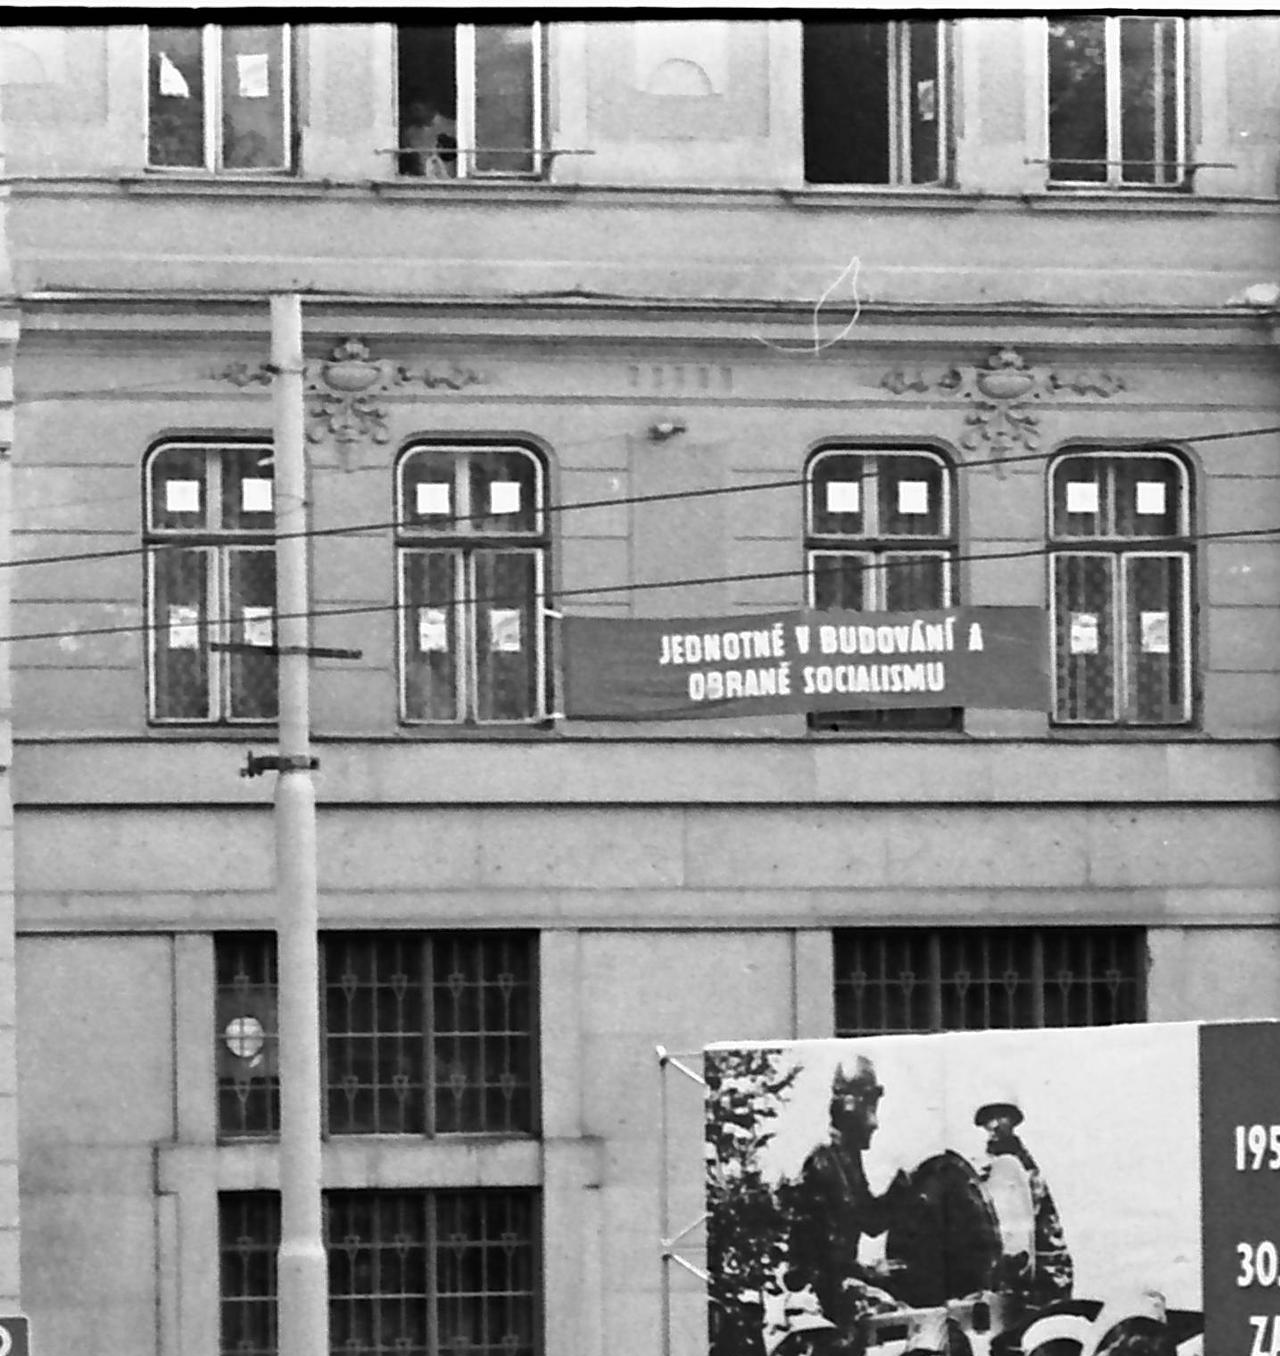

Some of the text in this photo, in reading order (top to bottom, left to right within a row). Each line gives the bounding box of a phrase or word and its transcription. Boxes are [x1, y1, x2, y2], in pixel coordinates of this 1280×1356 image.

[795, 625, 810, 654] V
[819, 616, 956, 654] BUDOVÁNÍ
[968, 622, 984, 651] A
[803, 661, 945, 694] SOCIALISMU
